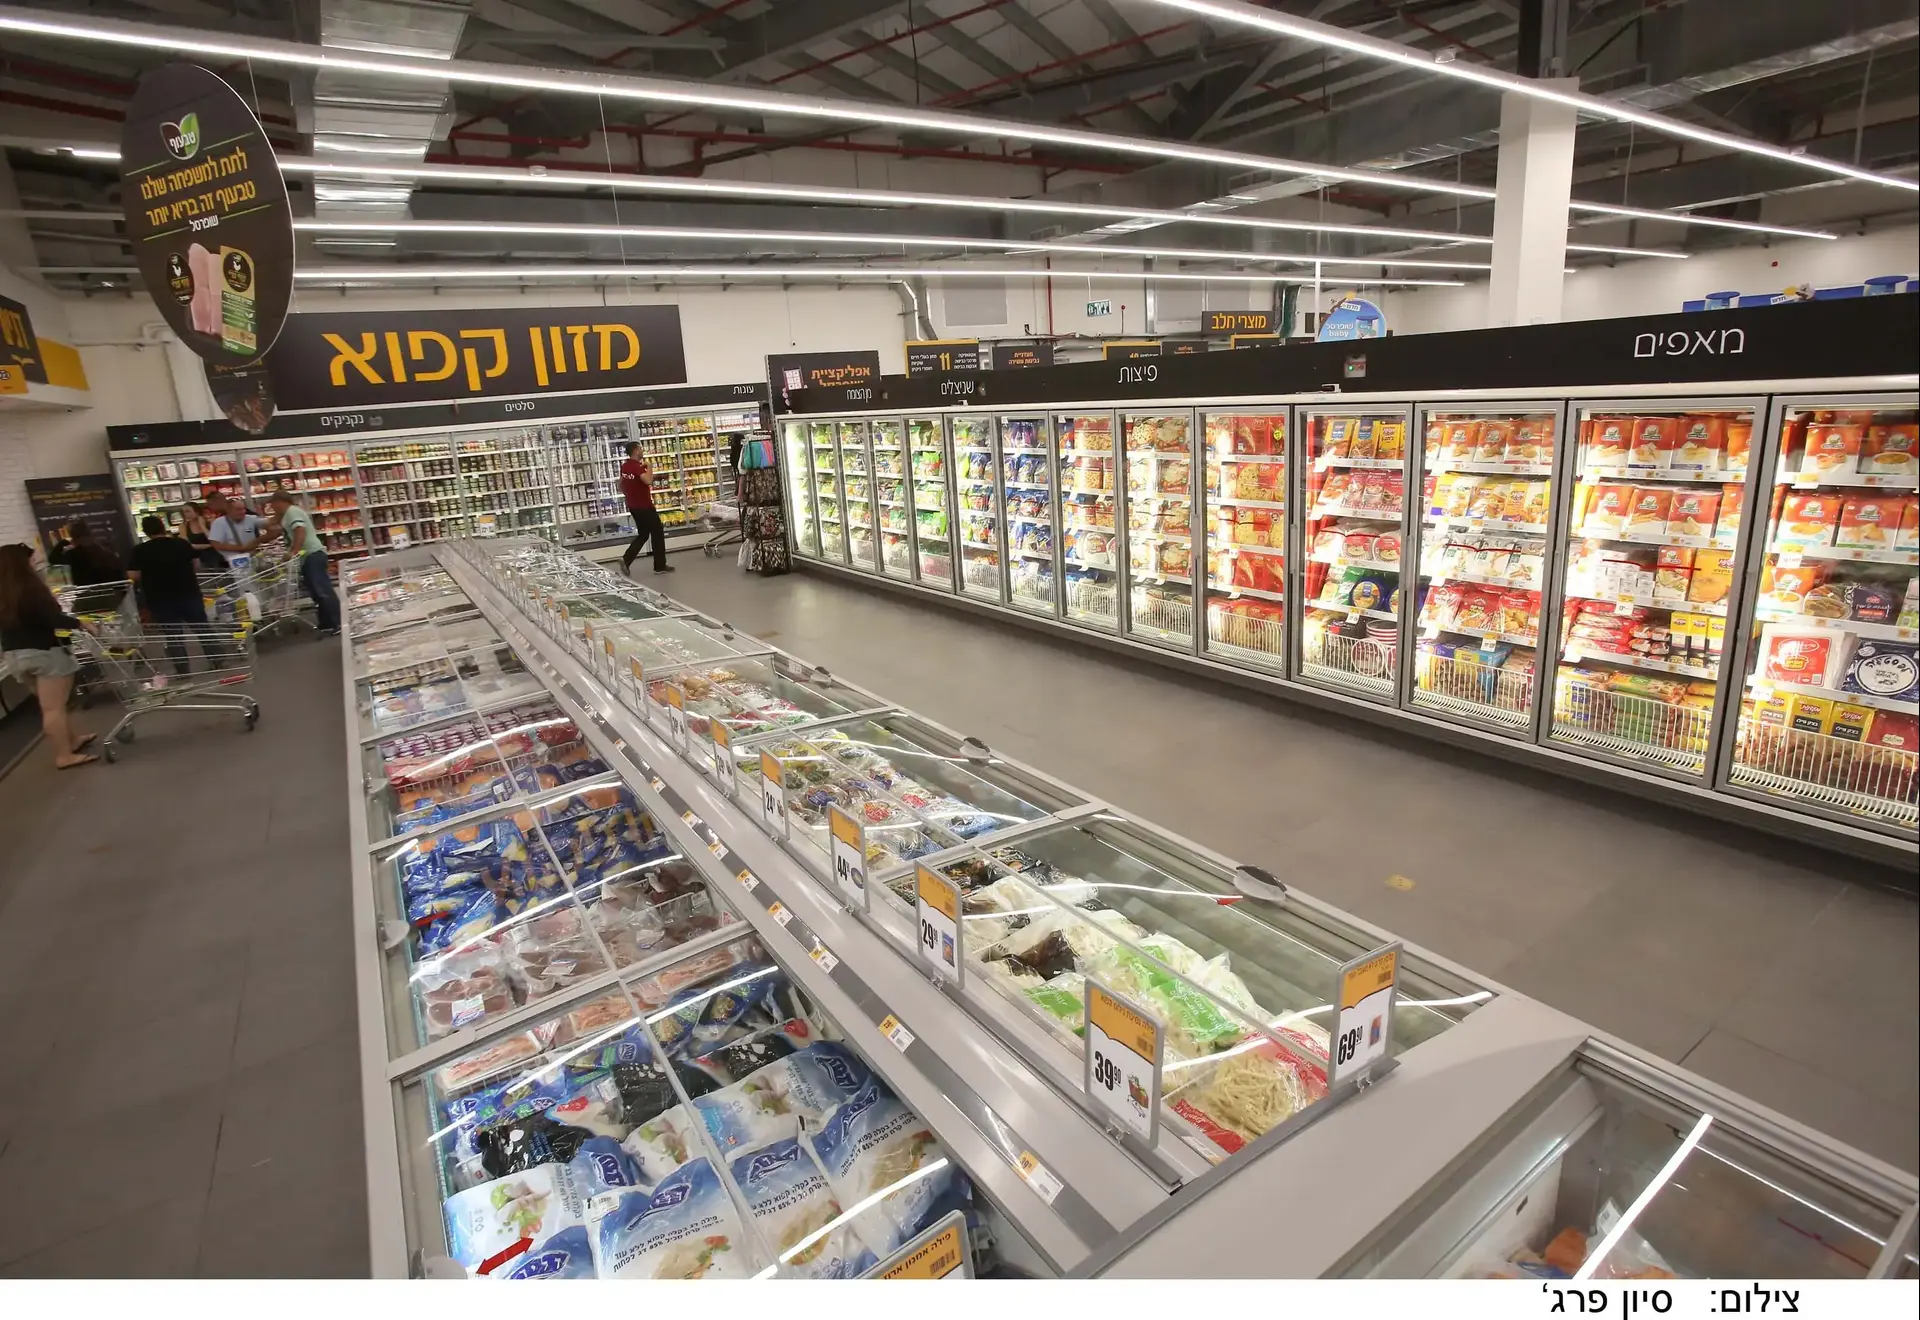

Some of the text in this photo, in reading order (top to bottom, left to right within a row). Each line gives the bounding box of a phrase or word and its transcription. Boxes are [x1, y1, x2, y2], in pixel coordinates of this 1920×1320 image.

[140, 146, 248, 200] לתת למשפחה שלנו
[146, 180, 256, 226] טבעוף זה בריא יותר
[188, 214, 219, 232] שופרסל
[1212, 313, 1266, 330] מוצרי חלב
[1634, 328, 1745, 358] מאפים
[322, 324, 640, 391] מזון קפוא
[940, 352, 951, 370] 11
[811, 364, 871, 380] אפליקציית
[1118, 364, 1158, 384] פיצות
[941, 380, 974, 395] שניצלים
[504, 400, 534, 412] סלטים
[320, 414, 364, 426] נקניקים
[873, 1123, 890, 1136] בקלה
[857, 1133, 872, 1144] קפוא
[792, 1180, 809, 1192] בקלה
[808, 1184, 822, 1194] קרח
[774, 1190, 790, 1202] קפוא
[759, 1199, 772, 1209] ללא
[701, 1216, 718, 1225] פילה
[668, 1227, 687, 1236] בקלה
[648, 1233, 665, 1244] קפוא
[665, 1234, 683, 1243] מכיל
[931, 1233, 951, 1250] פילה
[630, 1242, 644, 1252] ללא
[638, 1248, 647, 1256] דג
[616, 1250, 627, 1260] עור
[905, 1248, 928, 1269] אמנון
[614, 1254, 635, 1273] לפחות
